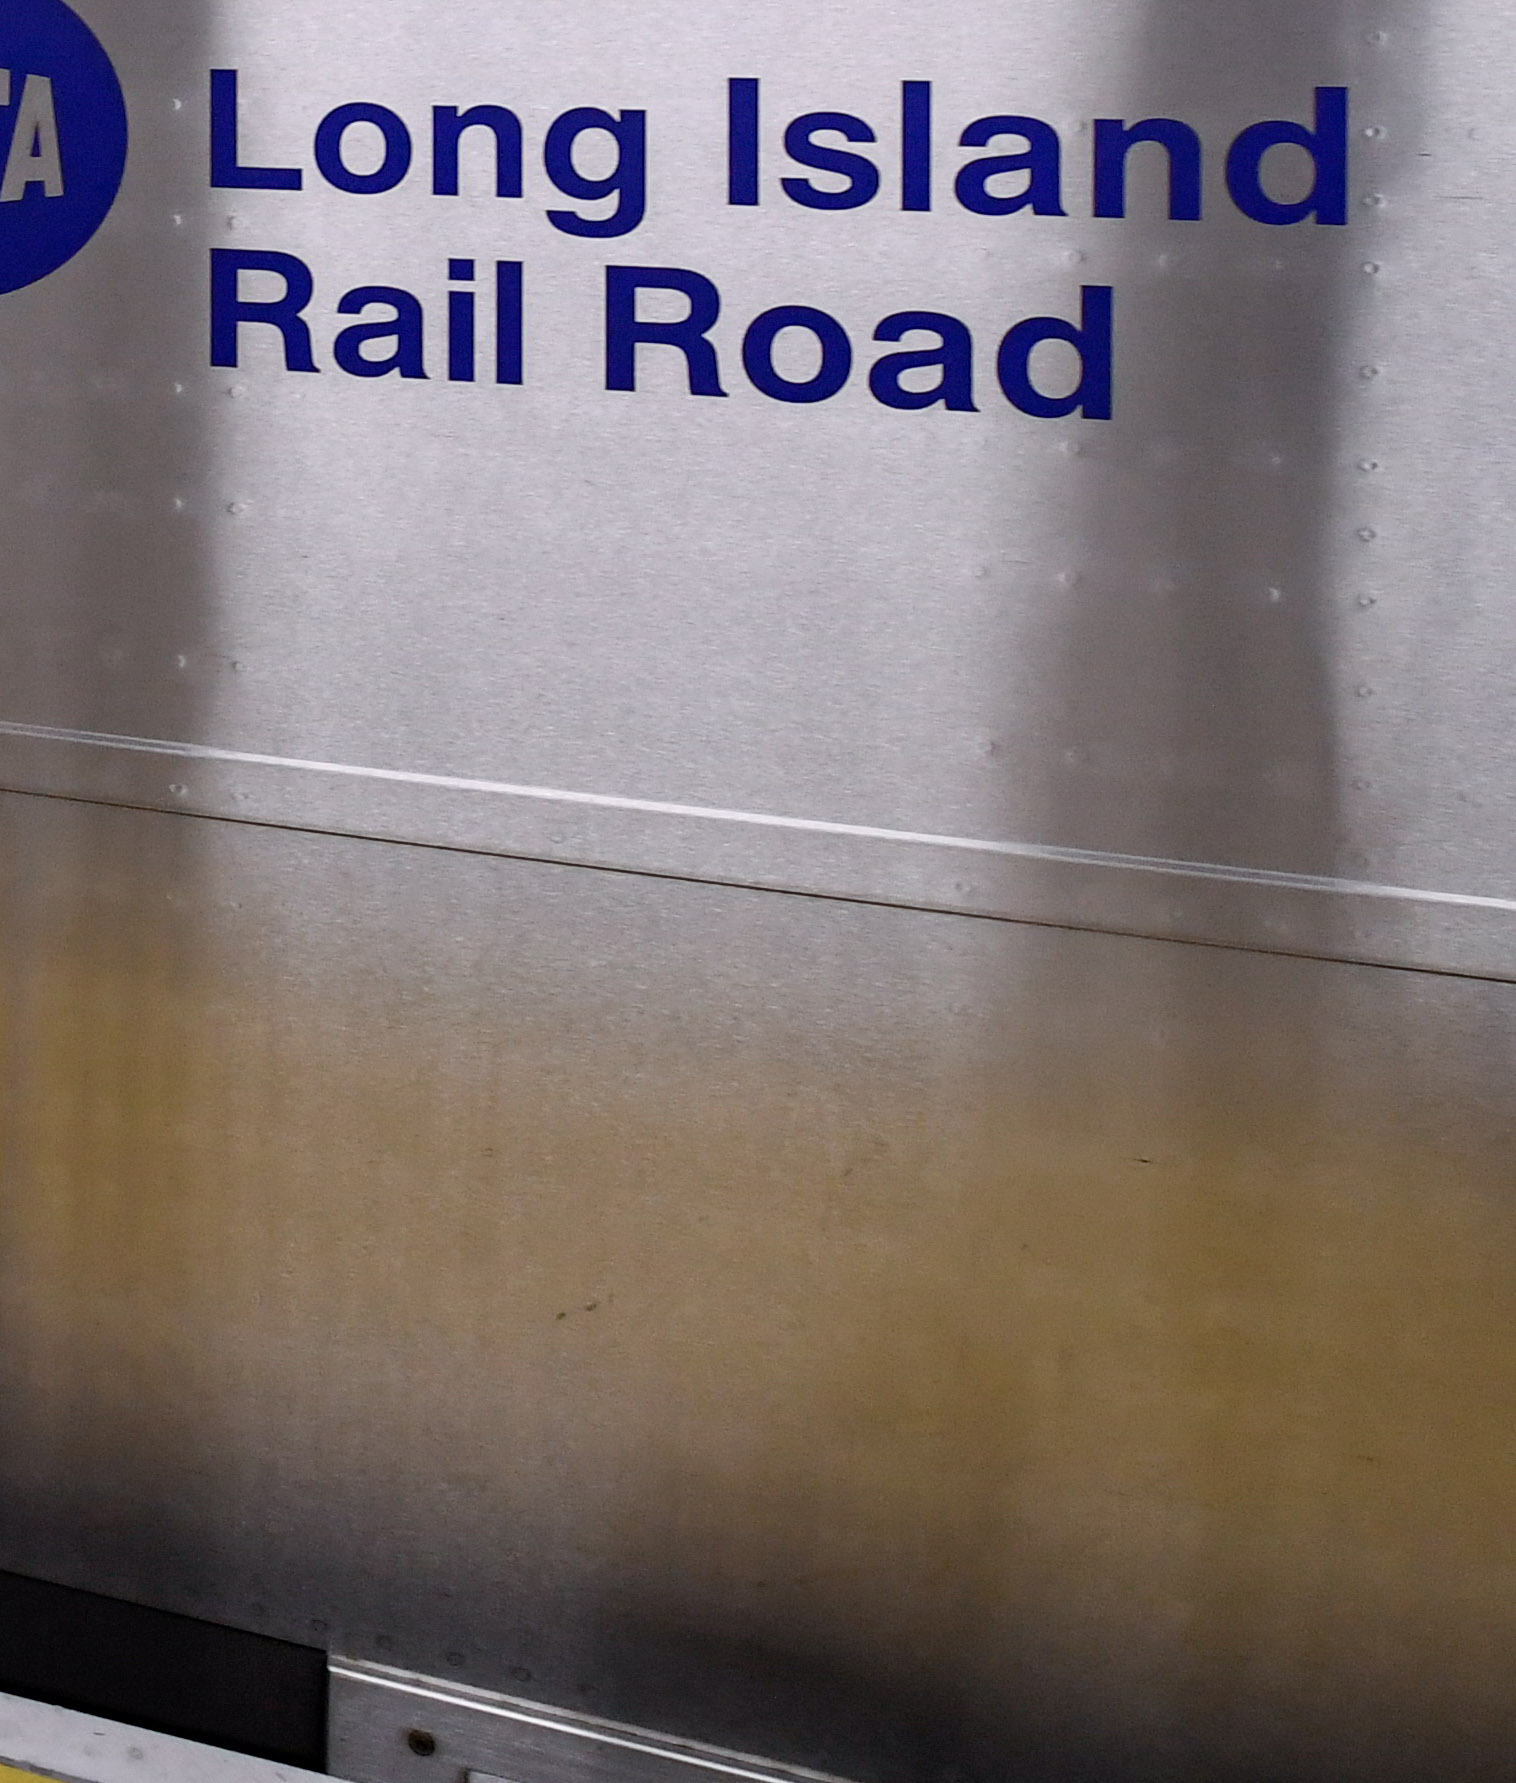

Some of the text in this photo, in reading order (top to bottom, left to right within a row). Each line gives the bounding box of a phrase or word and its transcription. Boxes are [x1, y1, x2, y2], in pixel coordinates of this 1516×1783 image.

[208, 68, 1350, 239] Long Island
[209, 247, 1115, 421] Rail Road
